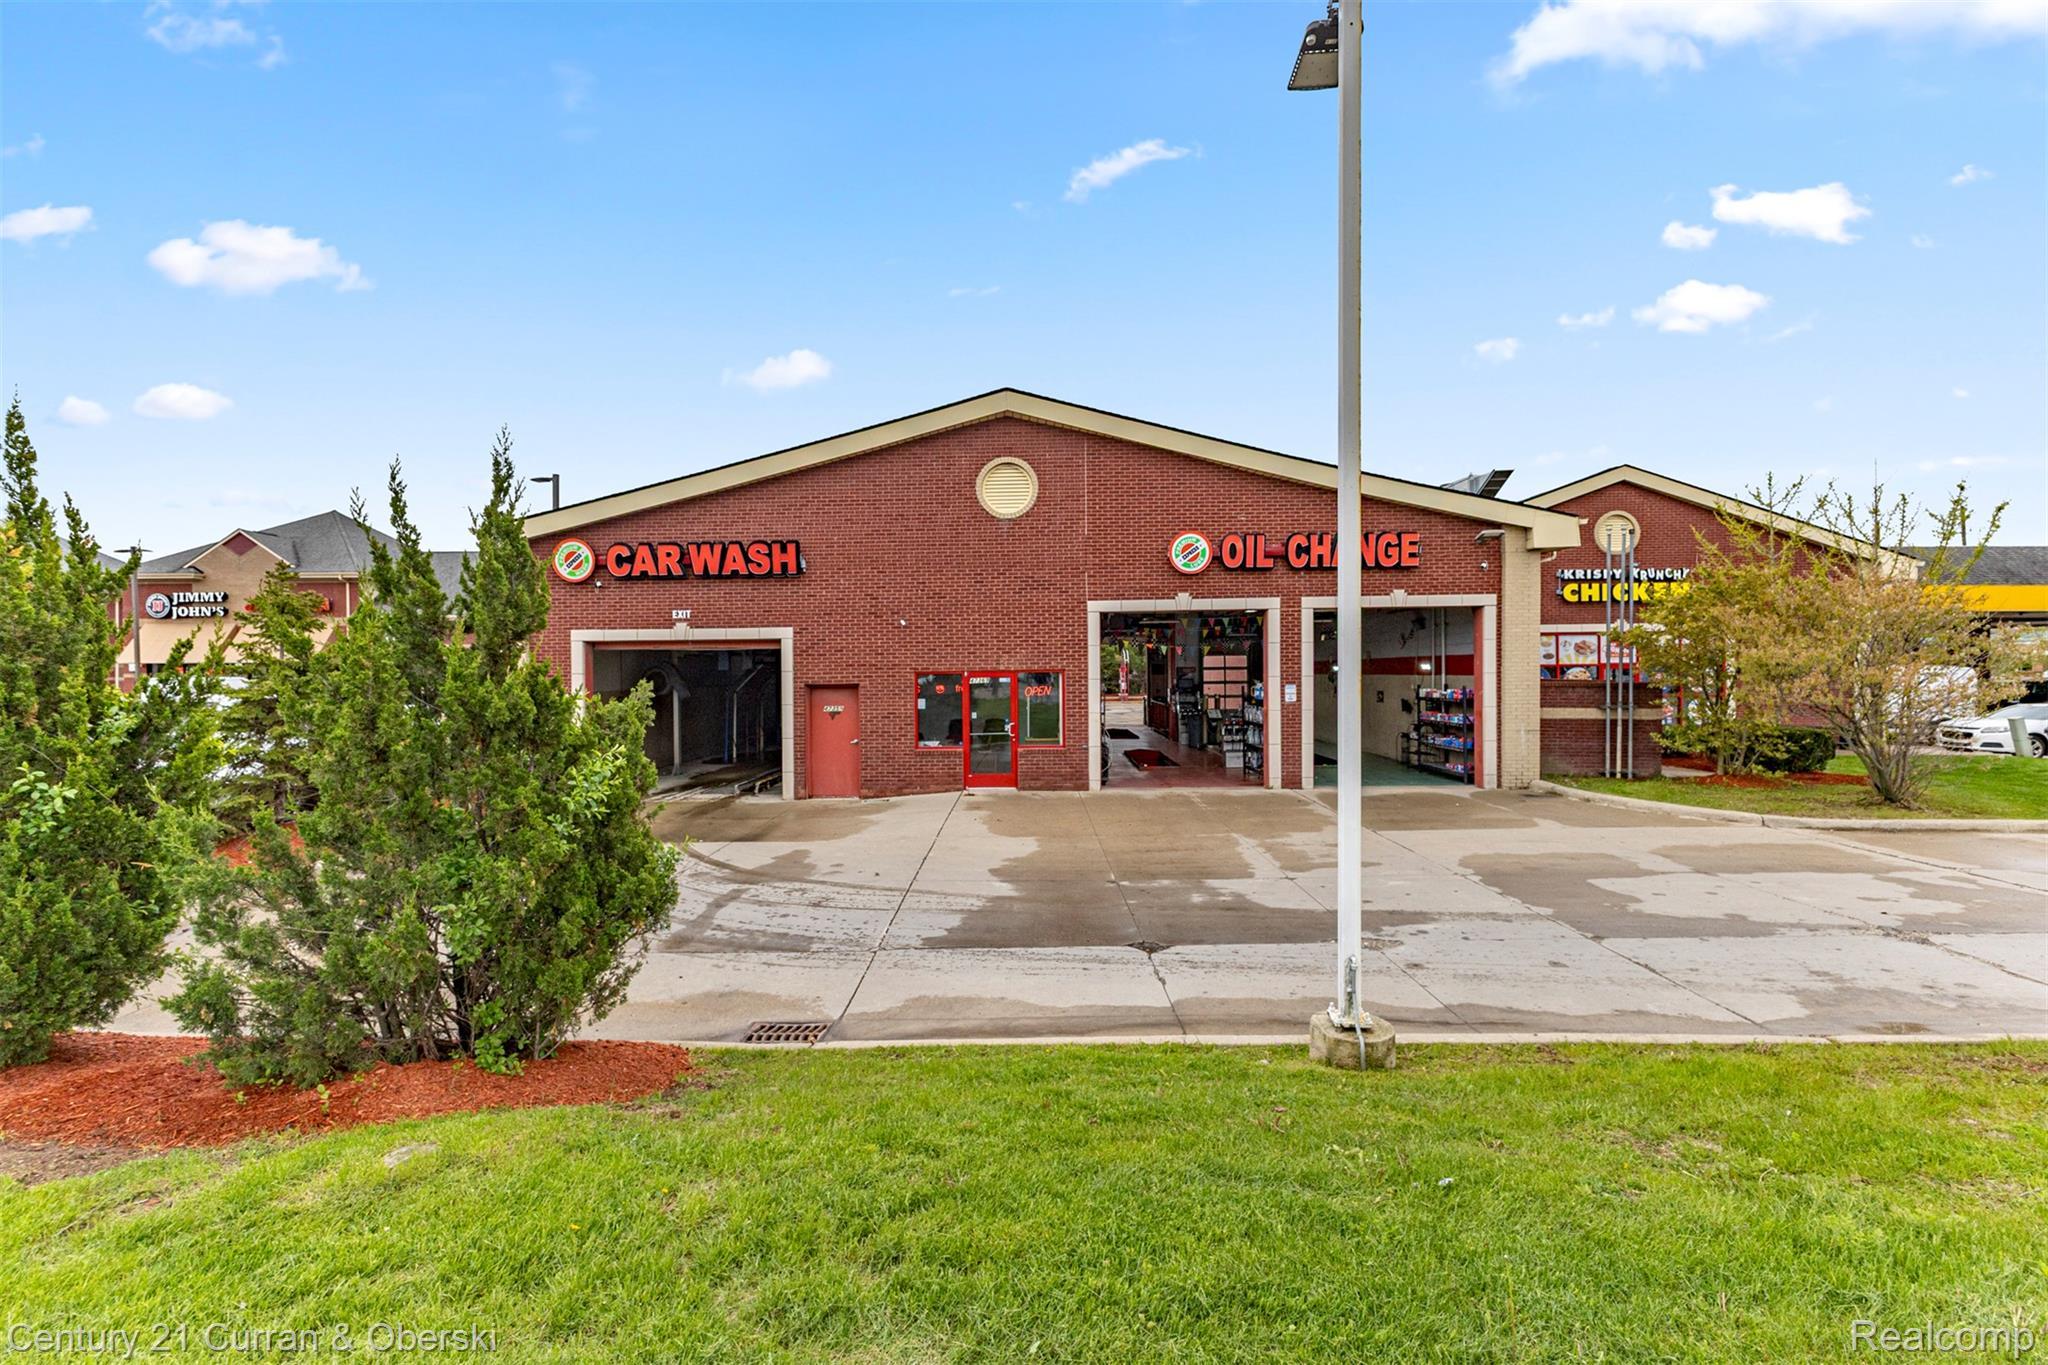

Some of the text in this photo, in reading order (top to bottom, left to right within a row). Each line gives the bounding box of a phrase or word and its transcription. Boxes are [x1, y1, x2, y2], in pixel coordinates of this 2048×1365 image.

[1221, 532, 1421, 569] OIL CHNGE
[606, 542, 797, 577] CAR WASH
[1632, 567, 1690, 581] KRUNCHY
[172, 591, 225, 605] JIMMY
[171, 606, 225, 620] JOHN'S
[672, 609, 691, 619] EXIT
[1024, 685, 1052, 697] OPEN
